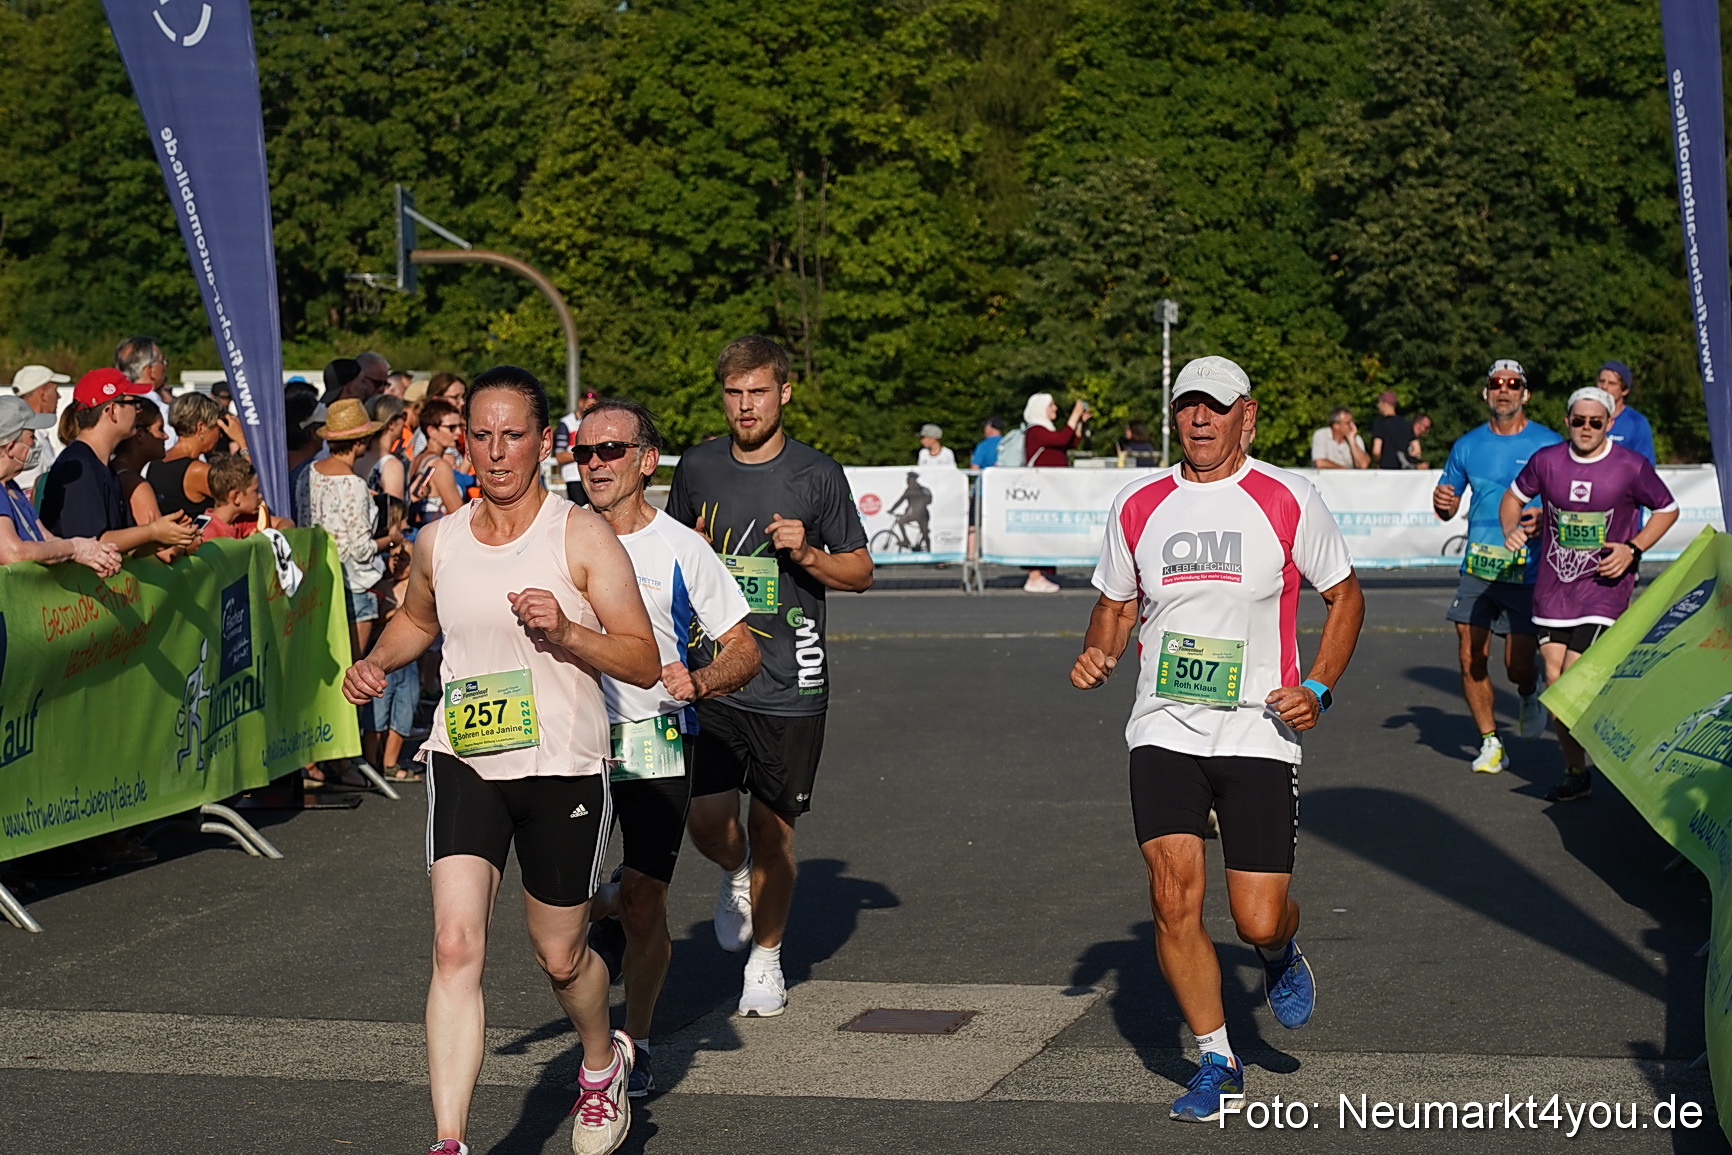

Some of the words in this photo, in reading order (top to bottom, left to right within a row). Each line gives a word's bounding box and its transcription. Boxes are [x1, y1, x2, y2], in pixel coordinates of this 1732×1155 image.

[1565, 524, 1597, 538] 1551
[1474, 554, 1506, 570] 1942
[735, 575, 759, 595] 55
[766, 579, 775, 606] 2022
[1160, 661, 1170, 685] RUN
[1175, 656, 1220, 683] 507
[1226, 666, 1238, 697] 2022
[1173, 679, 1192, 690] Roth
[1193, 682, 1218, 693] Klaus
[448, 710, 459, 748] WALK
[463, 698, 508, 730] 257
[520, 699, 534, 736] 2022
[457, 730, 480, 741] Bohren
[480, 728, 495, 737] Lea
[496, 724, 523, 735] Janine
[643, 739, 654, 770] 2022
[2, 770, 149, 838] www.firmenlauf-oberpfalz.de
